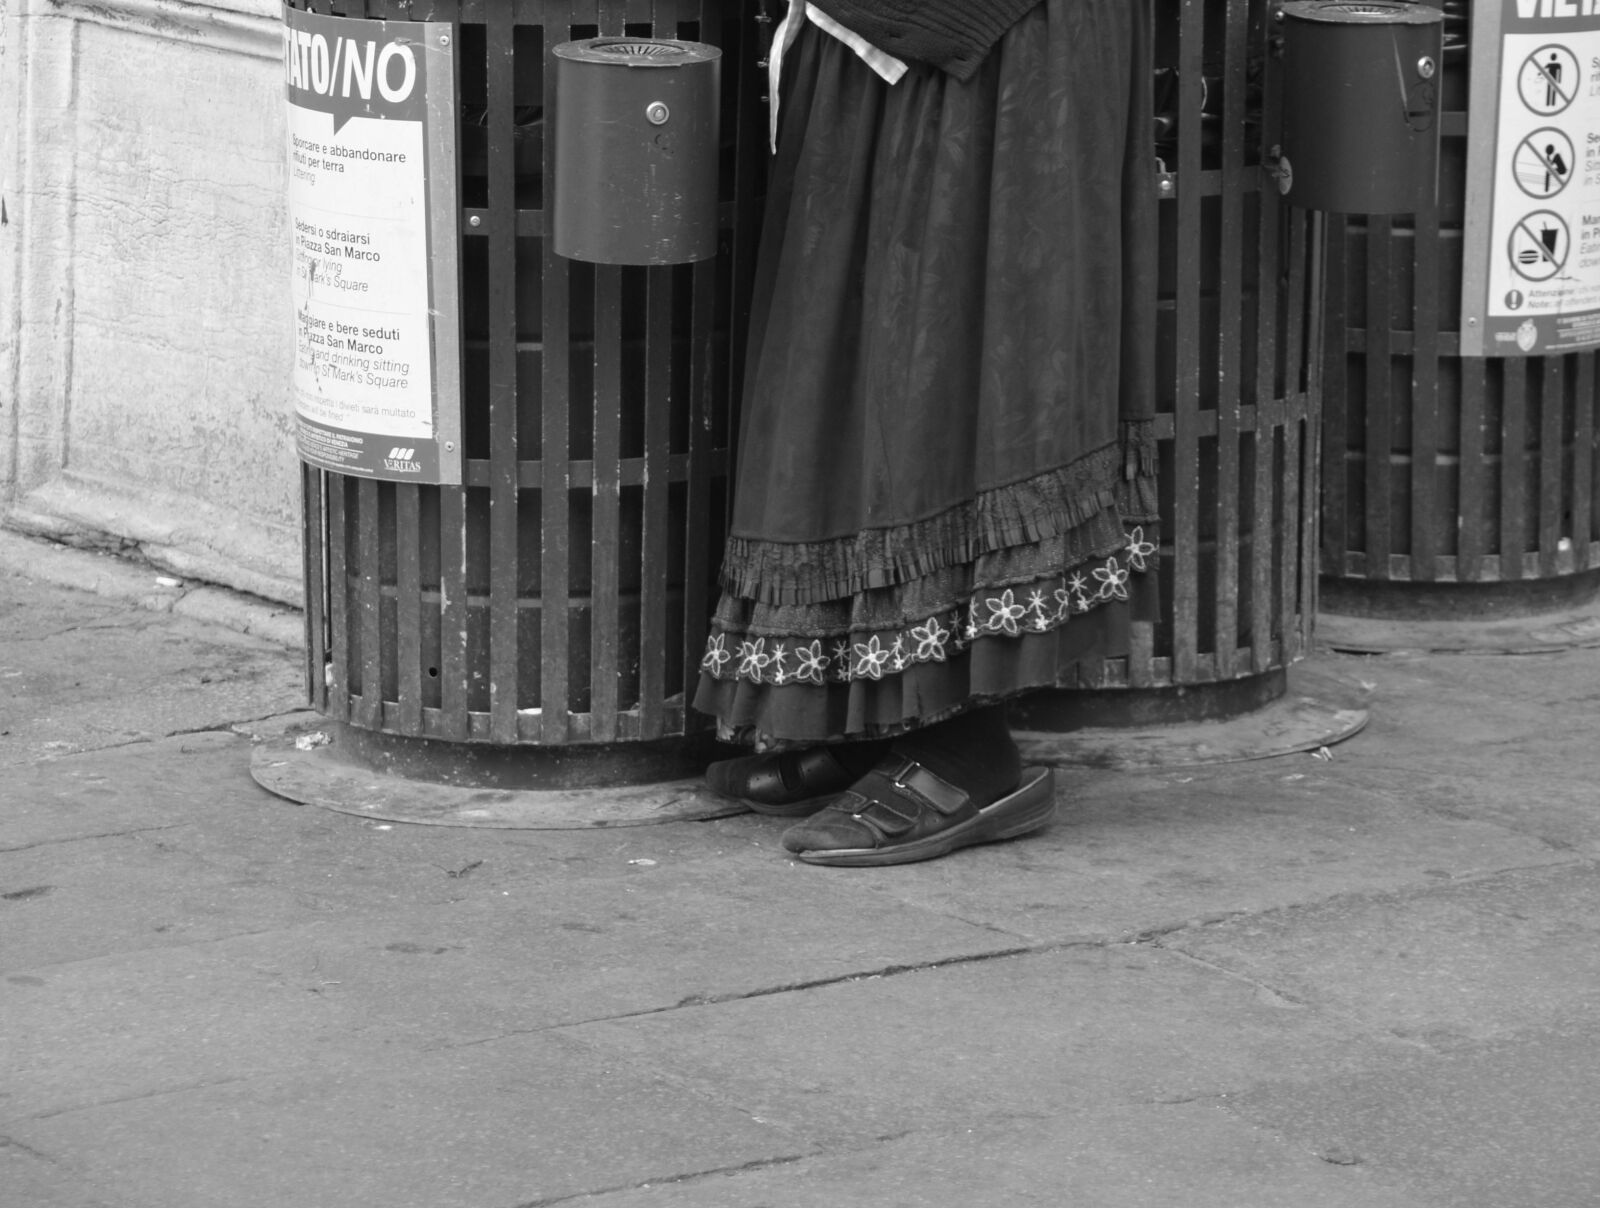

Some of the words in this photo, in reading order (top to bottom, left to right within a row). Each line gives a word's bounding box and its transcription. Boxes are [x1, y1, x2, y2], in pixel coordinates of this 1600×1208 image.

[330, 145, 406, 163] abbandonare
[308, 157, 321, 168] per
[322, 158, 345, 173] terra
[326, 228, 370, 245] sdraiarsi
[324, 241, 342, 257] San
[344, 246, 381, 262] Marco
[323, 257, 343, 275] lying
[333, 275, 369, 292] Square
[336, 321, 359, 336] bere
[362, 327, 400, 341] seduti
[327, 334, 344, 349] San
[347, 339, 383, 355] Marco
[331, 353, 370, 372] drinking
[373, 358, 410, 376] sitting
[366, 373, 409, 390] Square
[381, 406, 416, 418] multato
[384, 458, 421, 473] VERITAS
